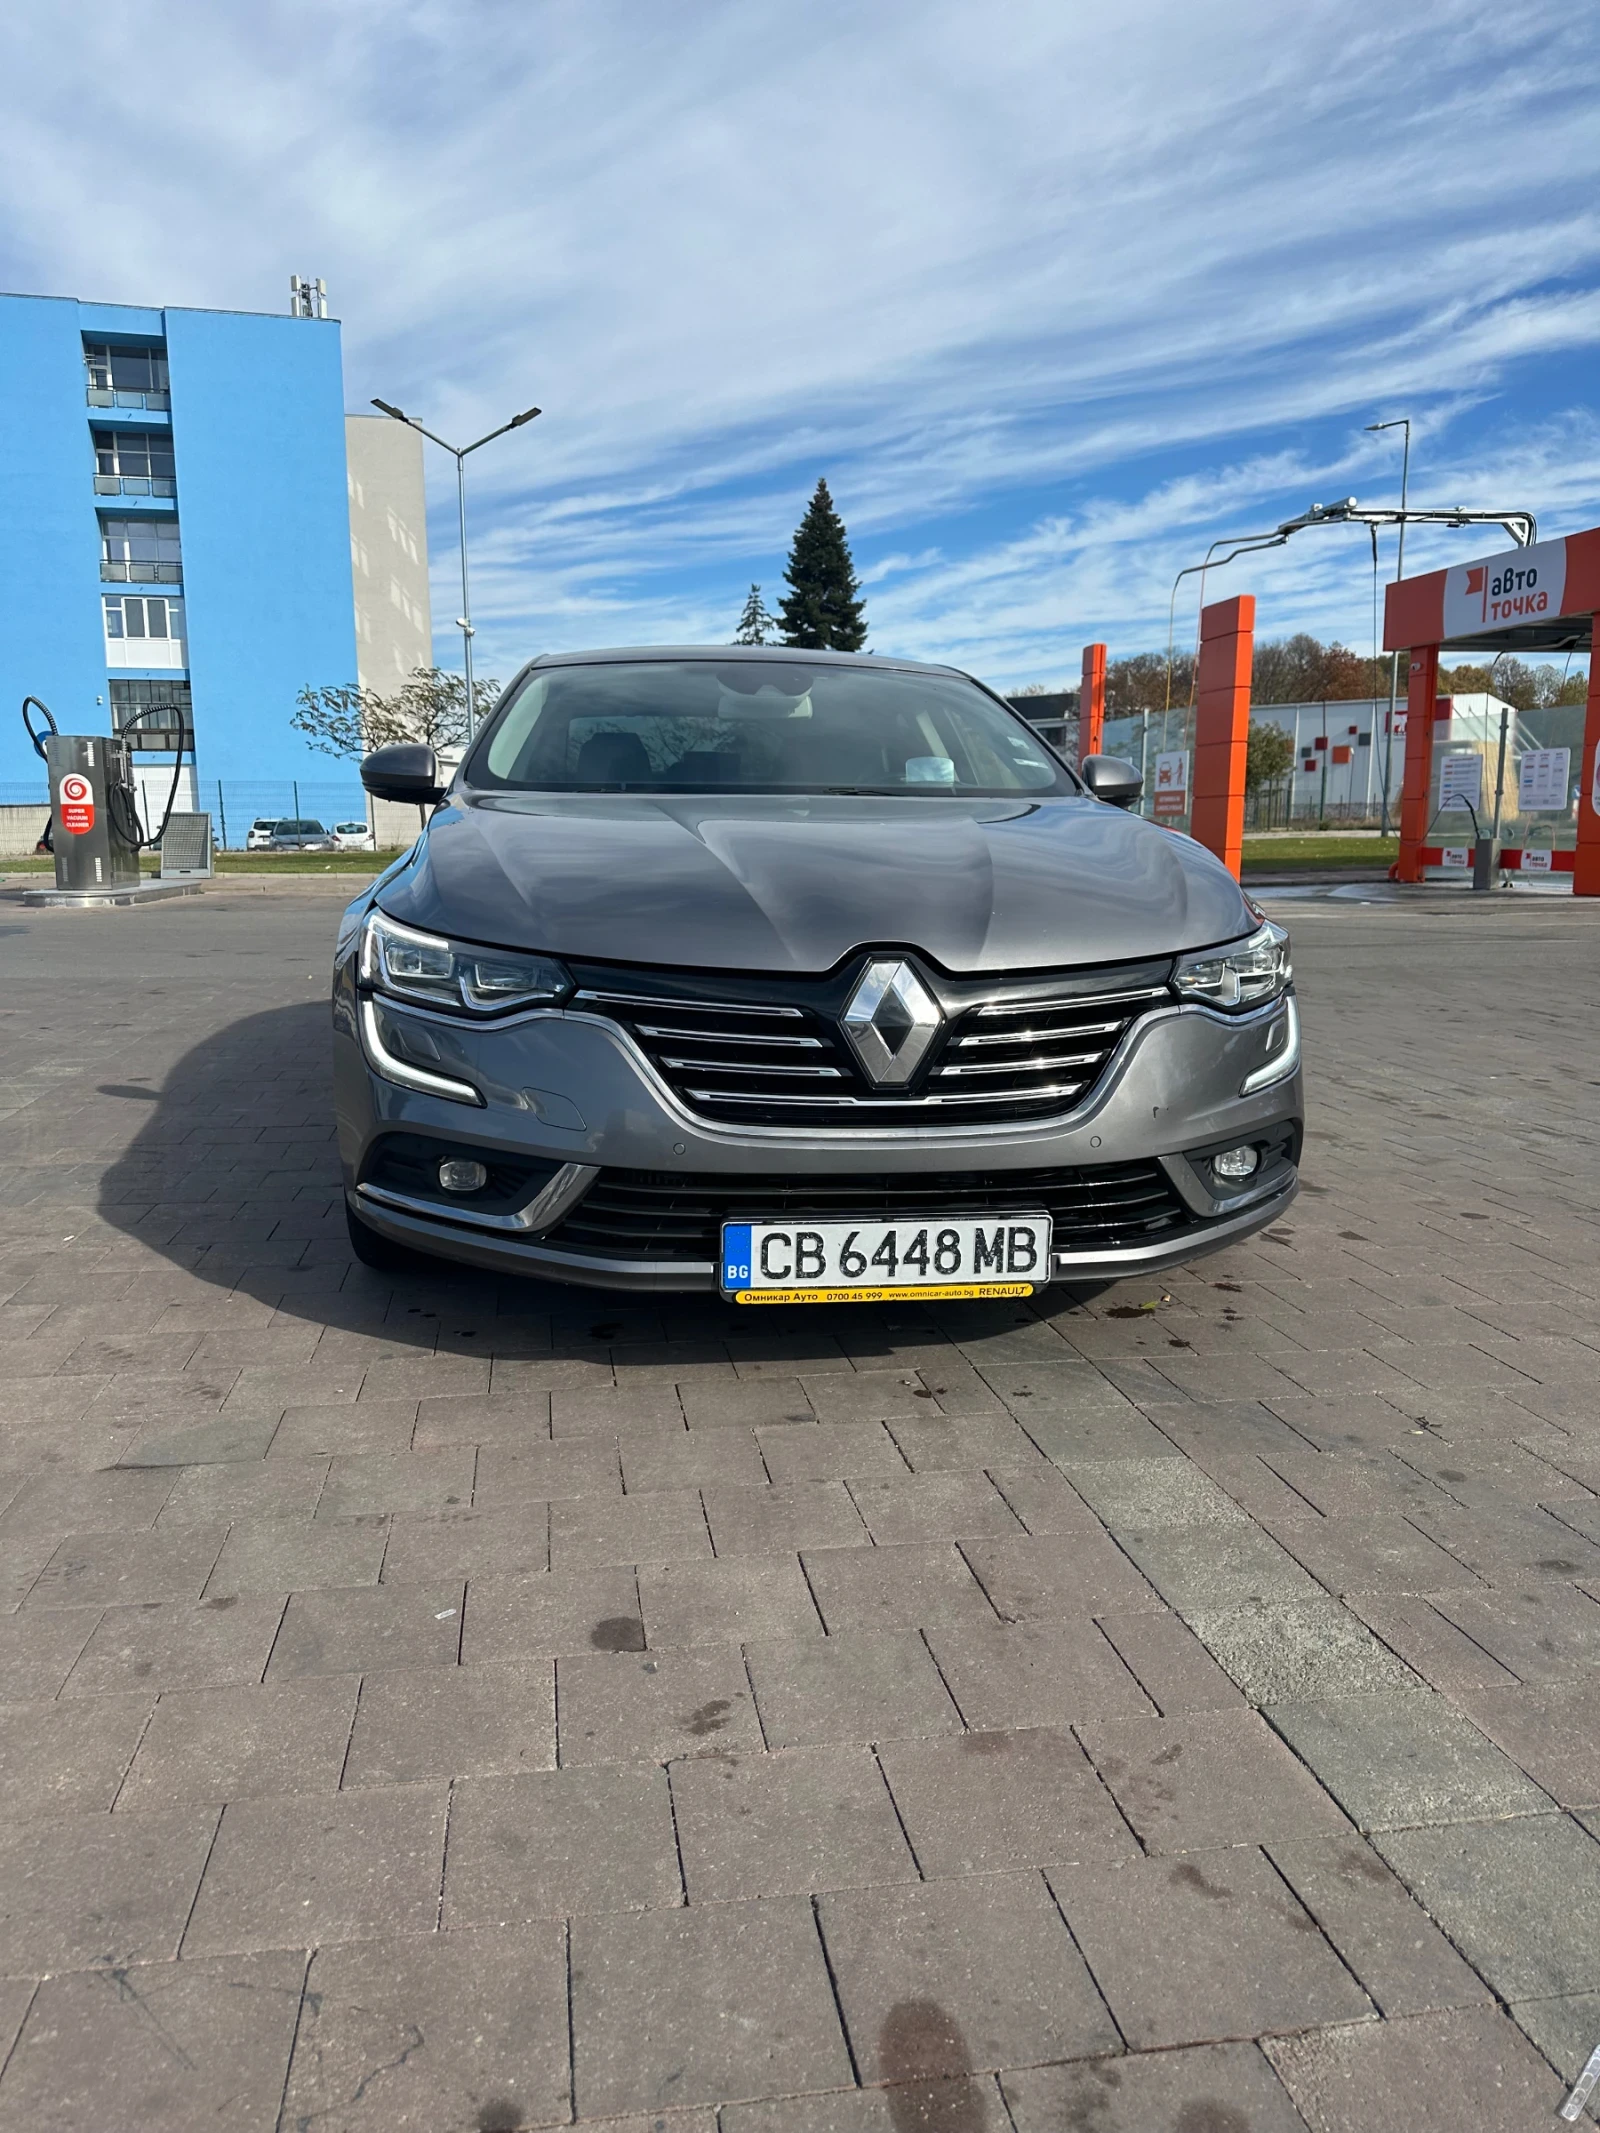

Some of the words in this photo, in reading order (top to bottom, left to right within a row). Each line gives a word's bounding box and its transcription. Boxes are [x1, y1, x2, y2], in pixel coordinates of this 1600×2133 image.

[1491, 567, 1538, 597] авто
[1491, 591, 1548, 621] точка
[760, 1231, 827, 1280] CB
[839, 1229, 962, 1278] 6448
[973, 1226, 1038, 1275] MB
[727, 1264, 749, 1279] BG
[744, 1293, 791, 1303] Омникар
[793, 1293, 818, 1302] Ауто
[826, 1293, 849, 1301] 0700
[865, 1292, 883, 1300] 999
[888, 1289, 974, 1299] www.omnicar-auto.bg
[979, 1286, 1026, 1296] RENAULT
